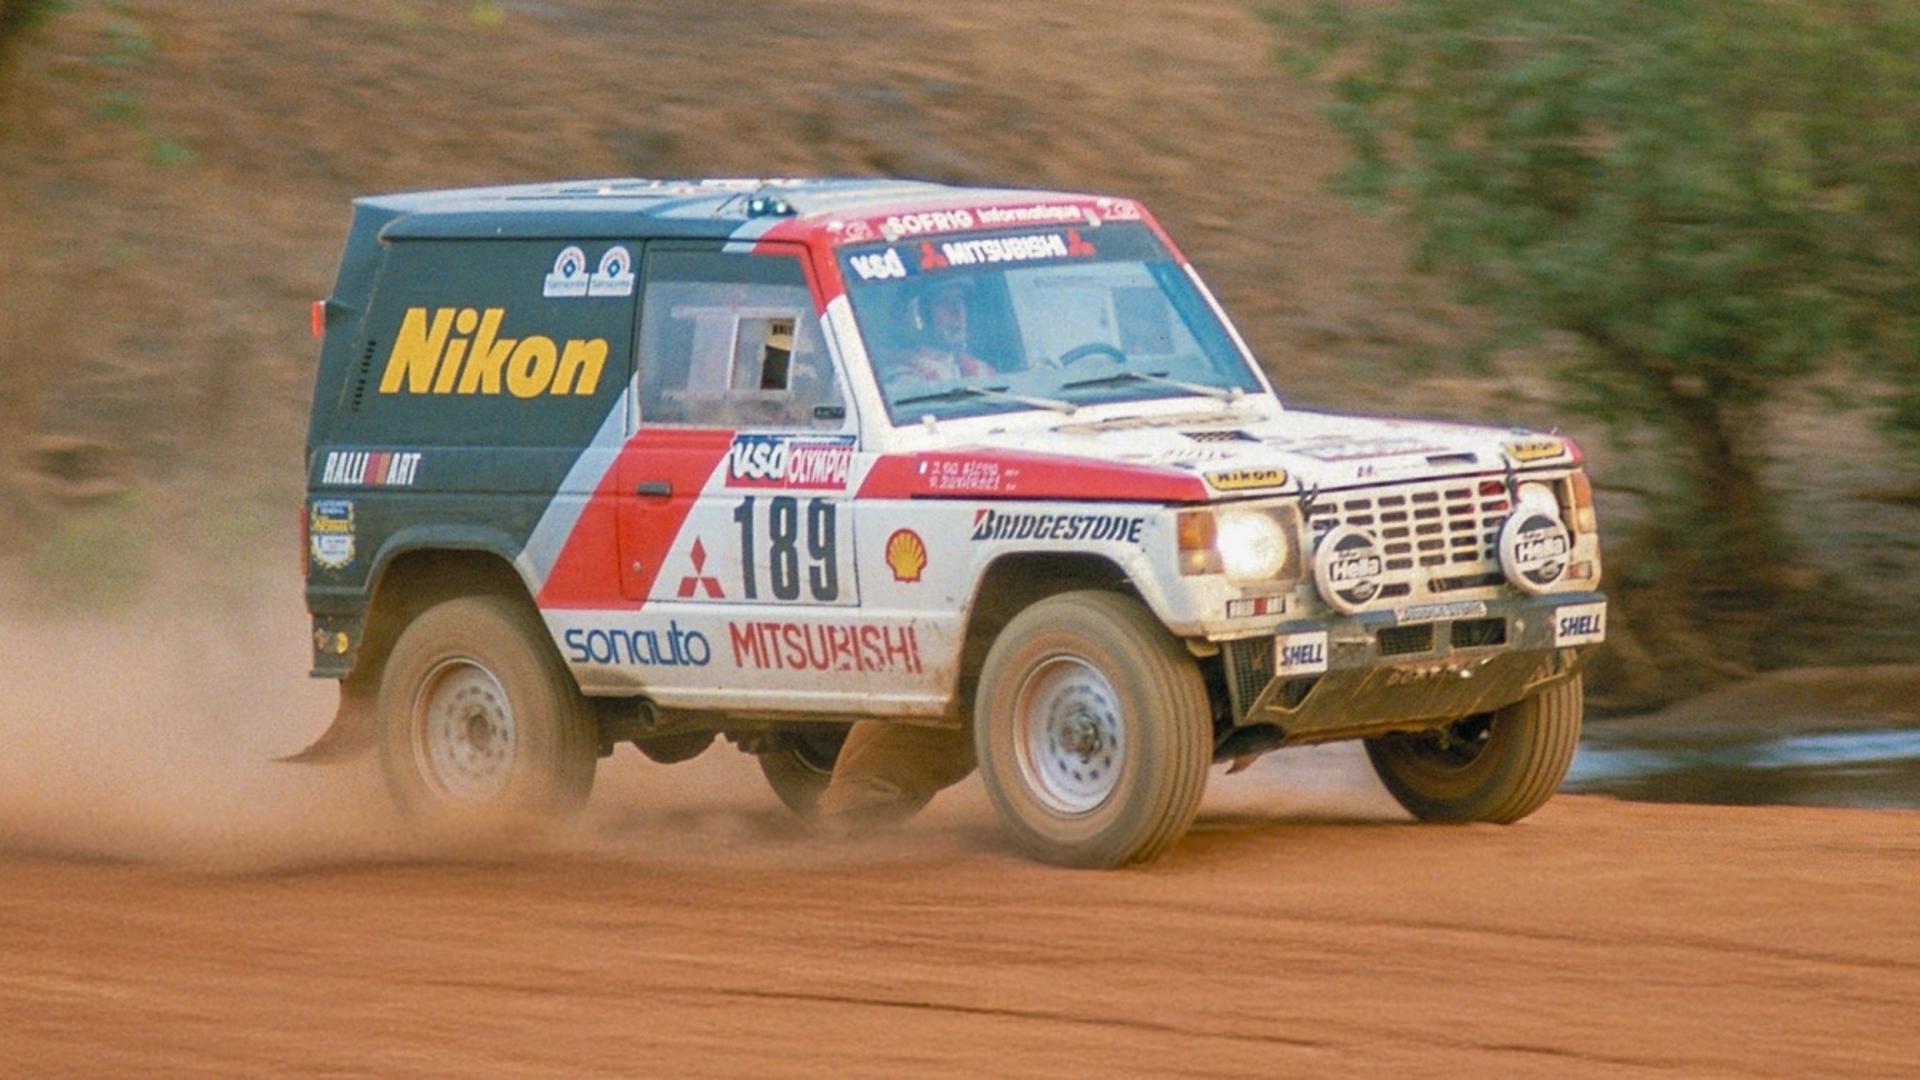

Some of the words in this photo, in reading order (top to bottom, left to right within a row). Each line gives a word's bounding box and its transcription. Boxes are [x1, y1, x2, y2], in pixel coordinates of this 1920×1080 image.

[941, 233, 1068, 266] MITSUBISHI
[378, 307, 609, 398] Nikon
[788, 448, 850, 484] OLYMPIA
[1217, 470, 1278, 483] Nikon
[971, 508, 1145, 544] BRIDGESTONE
[733, 494, 840, 602] 189
[1517, 536, 1565, 564] Hella
[1332, 556, 1380, 582] Hella
[1560, 613, 1601, 638] SHELL
[565, 620, 712, 667] sonauto
[728, 621, 923, 674] MITSUBISHI
[1280, 643, 1324, 667] SHELL
